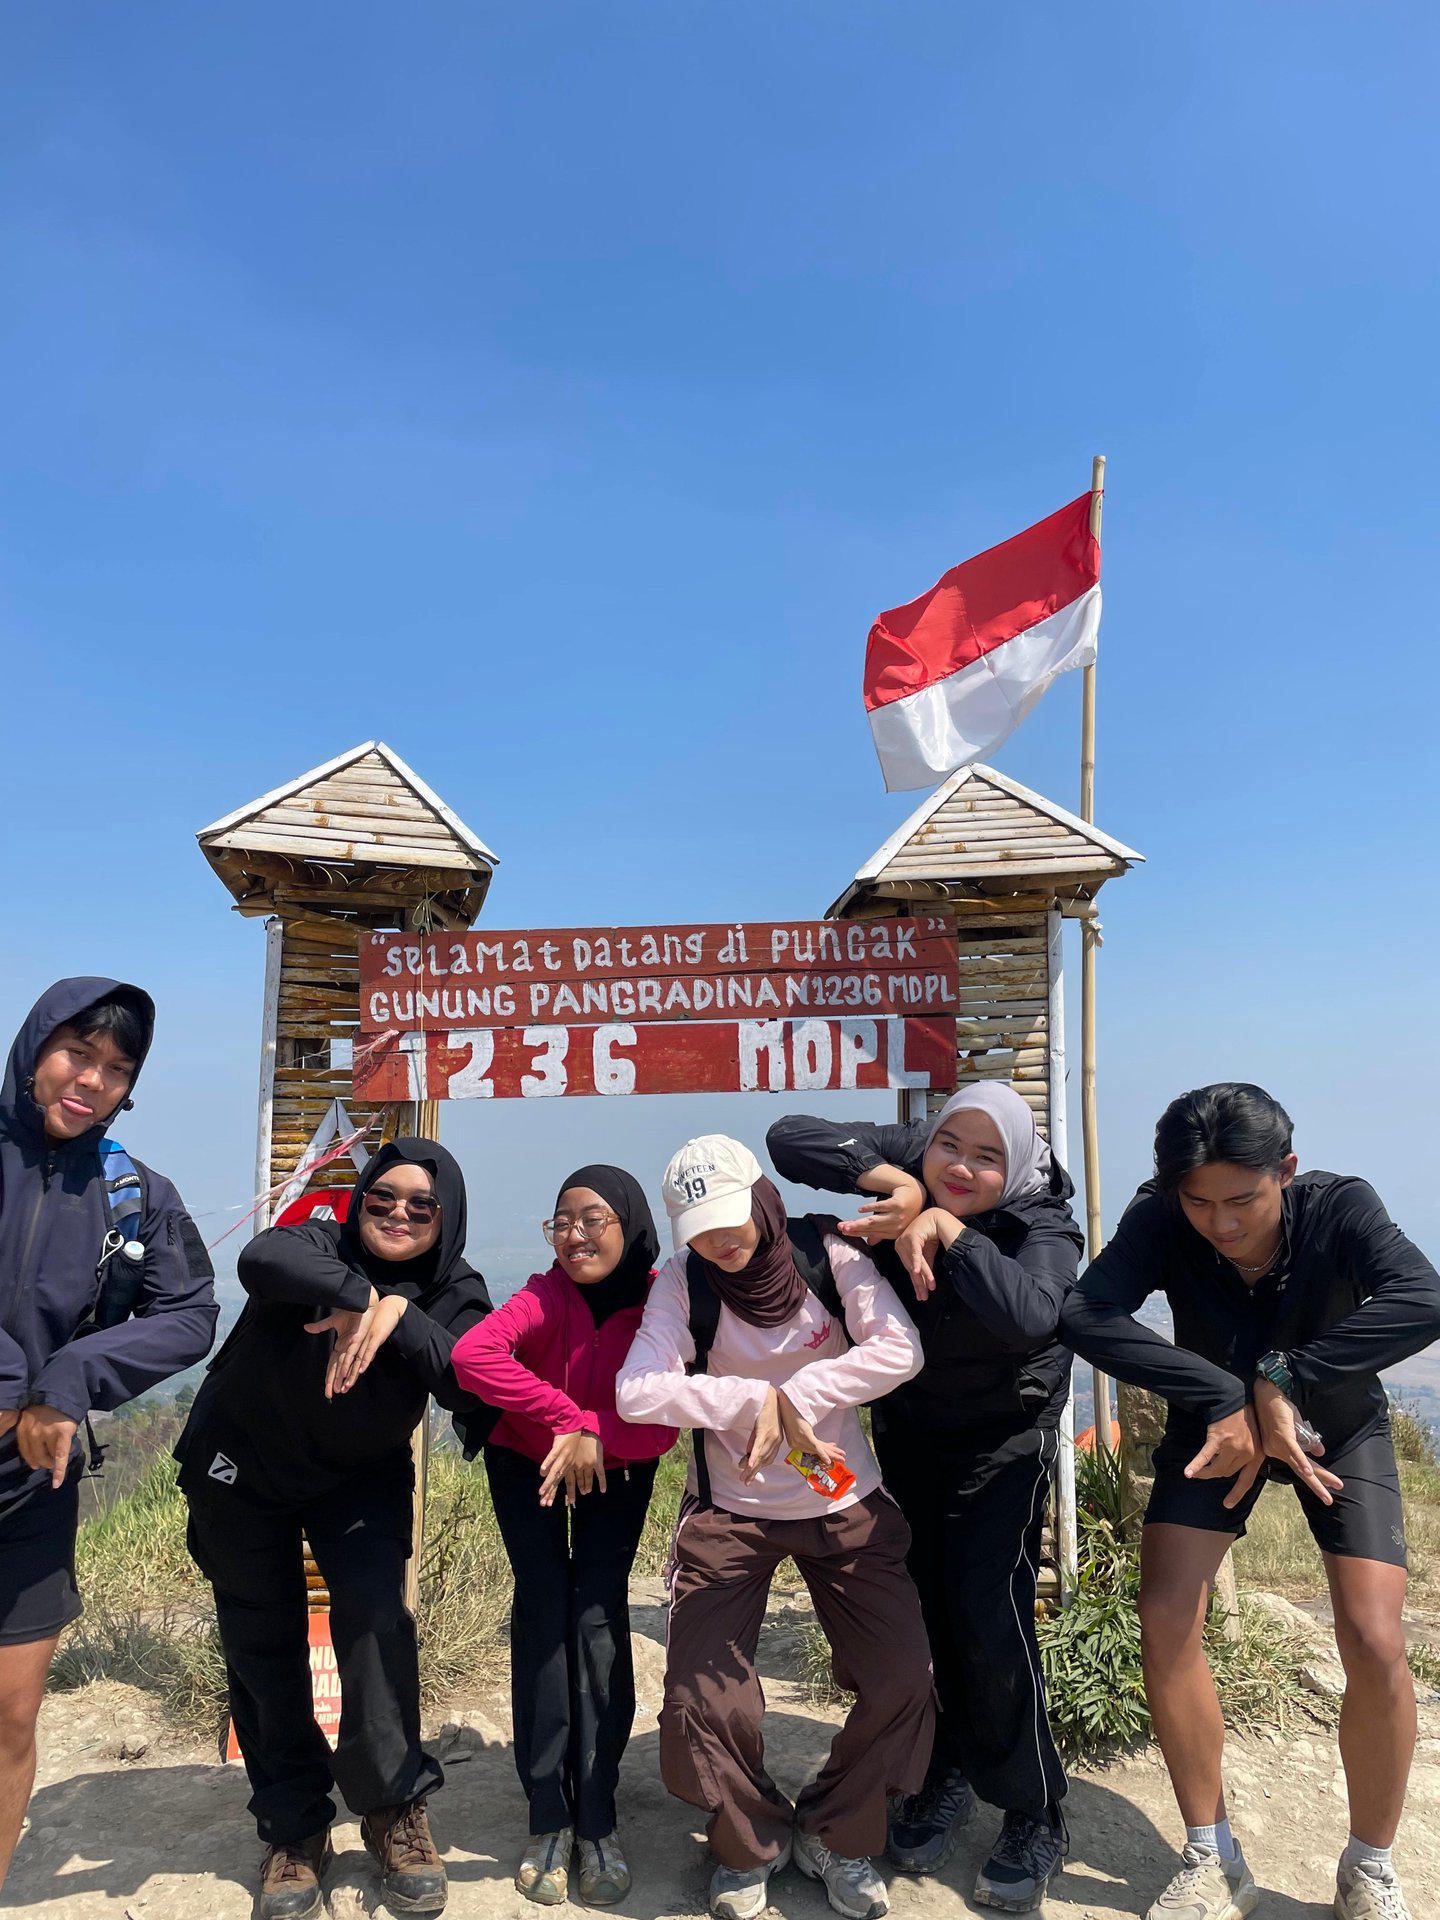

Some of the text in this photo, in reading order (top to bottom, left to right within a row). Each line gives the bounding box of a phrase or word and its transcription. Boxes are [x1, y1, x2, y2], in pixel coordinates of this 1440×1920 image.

[717, 924, 749, 964] di
[369, 984, 517, 1023] GUNUNG
[530, 974, 810, 1017] PANGRADINAN
[888, 974, 957, 1004] MDPL
[738, 1019, 931, 1092] MDPL
[674, 1164, 716, 1187] NNETEEN
[685, 1177, 706, 1203] 19
